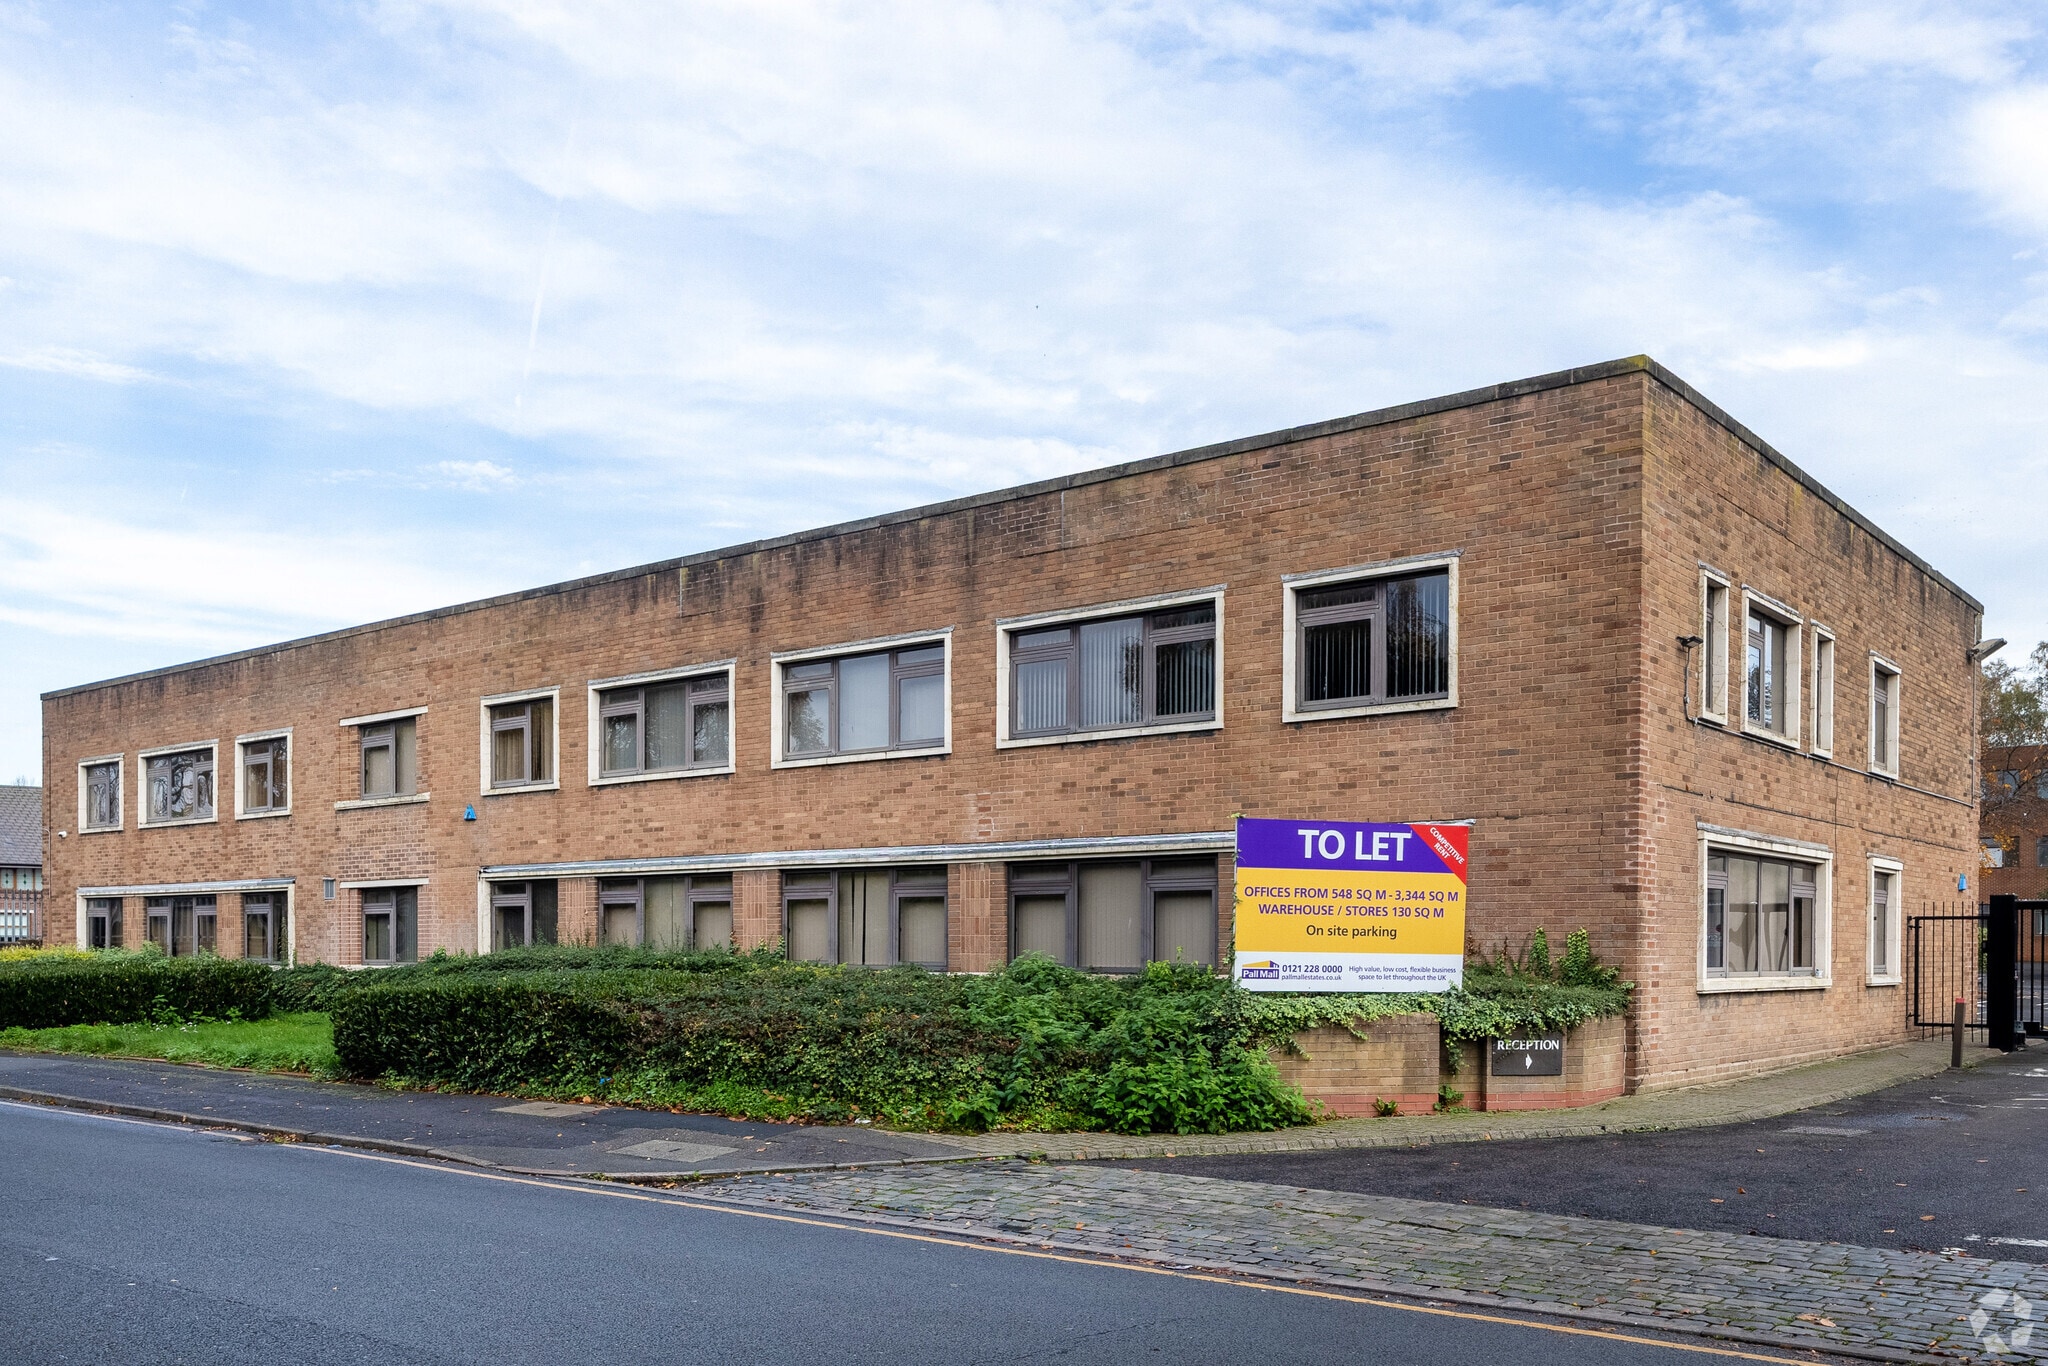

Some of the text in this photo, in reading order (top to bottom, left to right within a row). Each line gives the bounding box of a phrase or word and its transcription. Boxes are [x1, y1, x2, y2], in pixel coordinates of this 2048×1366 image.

[1298, 829, 1412, 861] TO LET
[1430, 827, 1465, 865] COMPETITIVE
[1433, 842, 1451, 859] RENT
[1244, 886, 1290, 898] OFFICES
[1294, 887, 1328, 899] FROM
[1332, 888, 1352, 899] 548
[1356, 889, 1372, 901] SQ
[1375, 889, 1387, 900] M
[1394, 890, 1425, 902] 3,344
[1429, 891, 1444, 903] SQ
[1447, 891, 1458, 901] M
[1258, 903, 1444, 919] WAREHOUSE / STORES 130 SQ M
[1306, 924, 1397, 940] On site parking
[1243, 969, 1278, 978] Pall Mall
[1282, 964, 1343, 973] 0121 228 0000
[1348, 965, 1363, 973] High
[1497, 1039, 1560, 1051] RECEPTION
